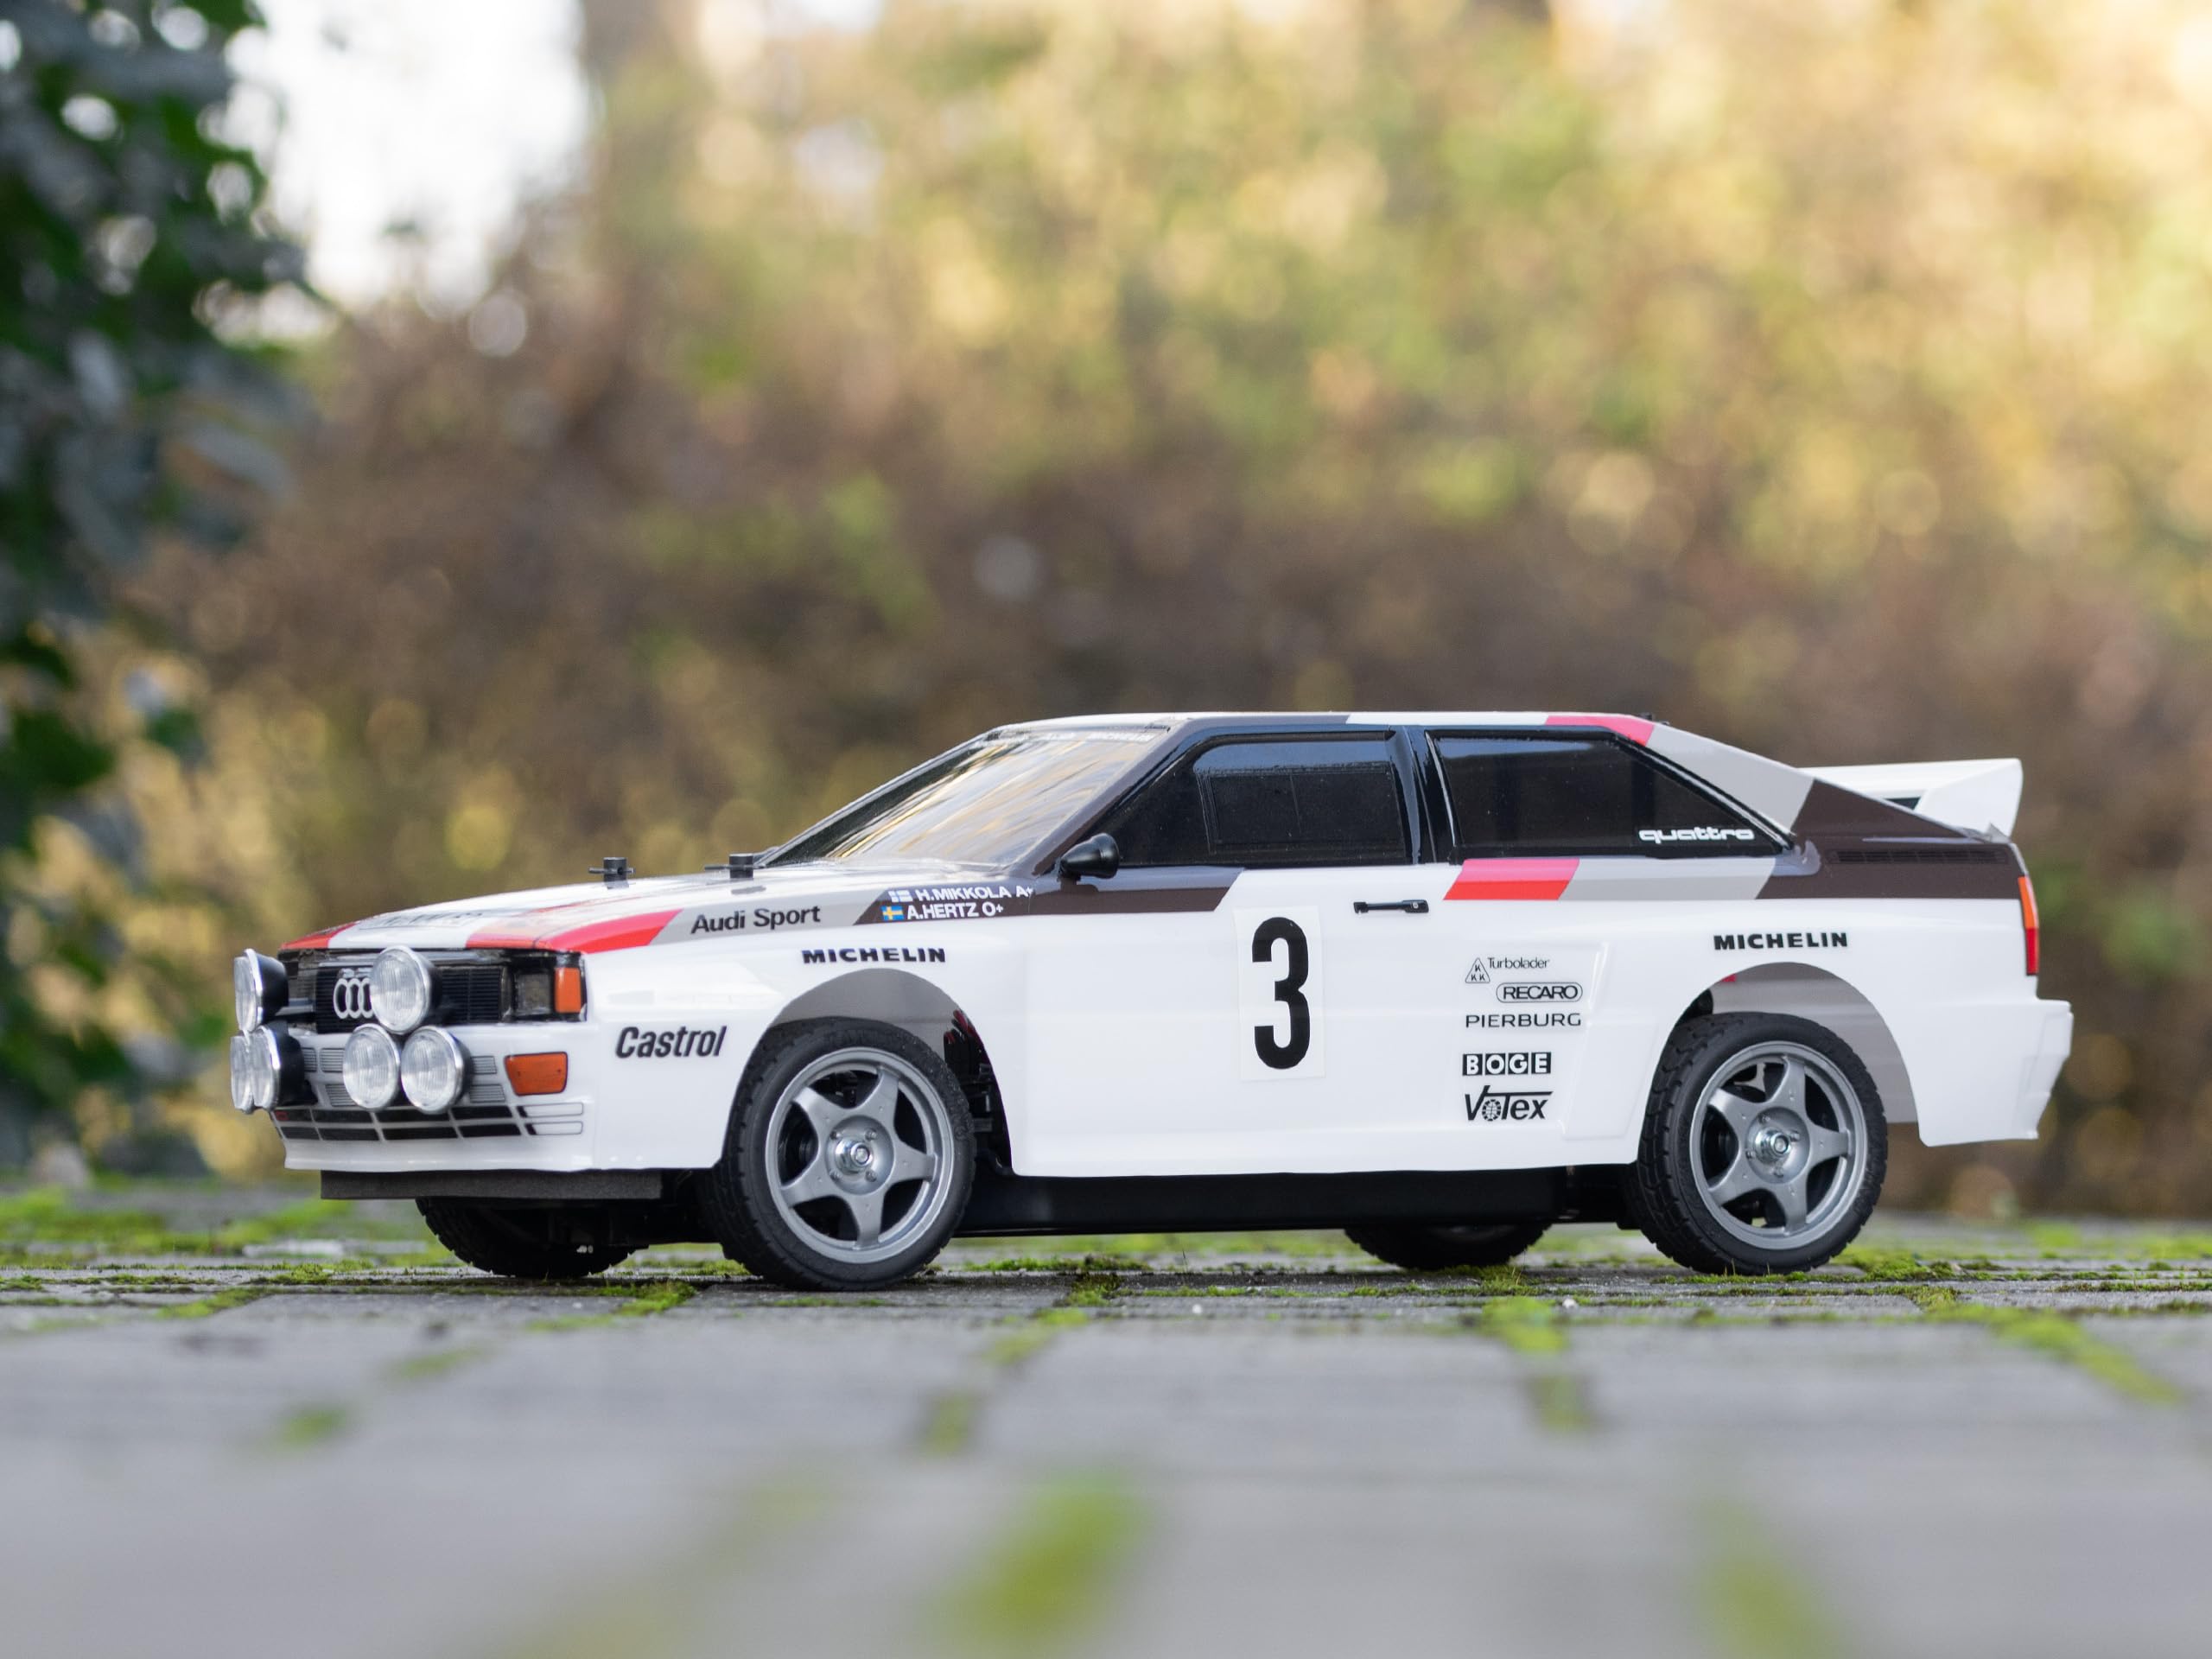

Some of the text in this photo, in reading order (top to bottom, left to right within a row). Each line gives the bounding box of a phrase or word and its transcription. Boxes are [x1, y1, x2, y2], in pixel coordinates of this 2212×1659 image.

[1638, 827, 1755, 844] quattro
[915, 885, 1012, 901] H.MIKKOLA
[907, 902, 979, 919] A.HERTZ
[690, 905, 822, 935] Audi Sport
[1713, 932, 1848, 950] MICHELIN
[801, 948, 946, 964] MICHELIN
[1487, 957, 1549, 969] Turbolader
[1251, 917, 1310, 1070] 3
[1503, 984, 1579, 1001] RECARO
[1465, 1013, 1581, 1028] PIERBURG
[615, 1025, 728, 1059] Castrol
[1463, 1052, 1552, 1076] BOGE
